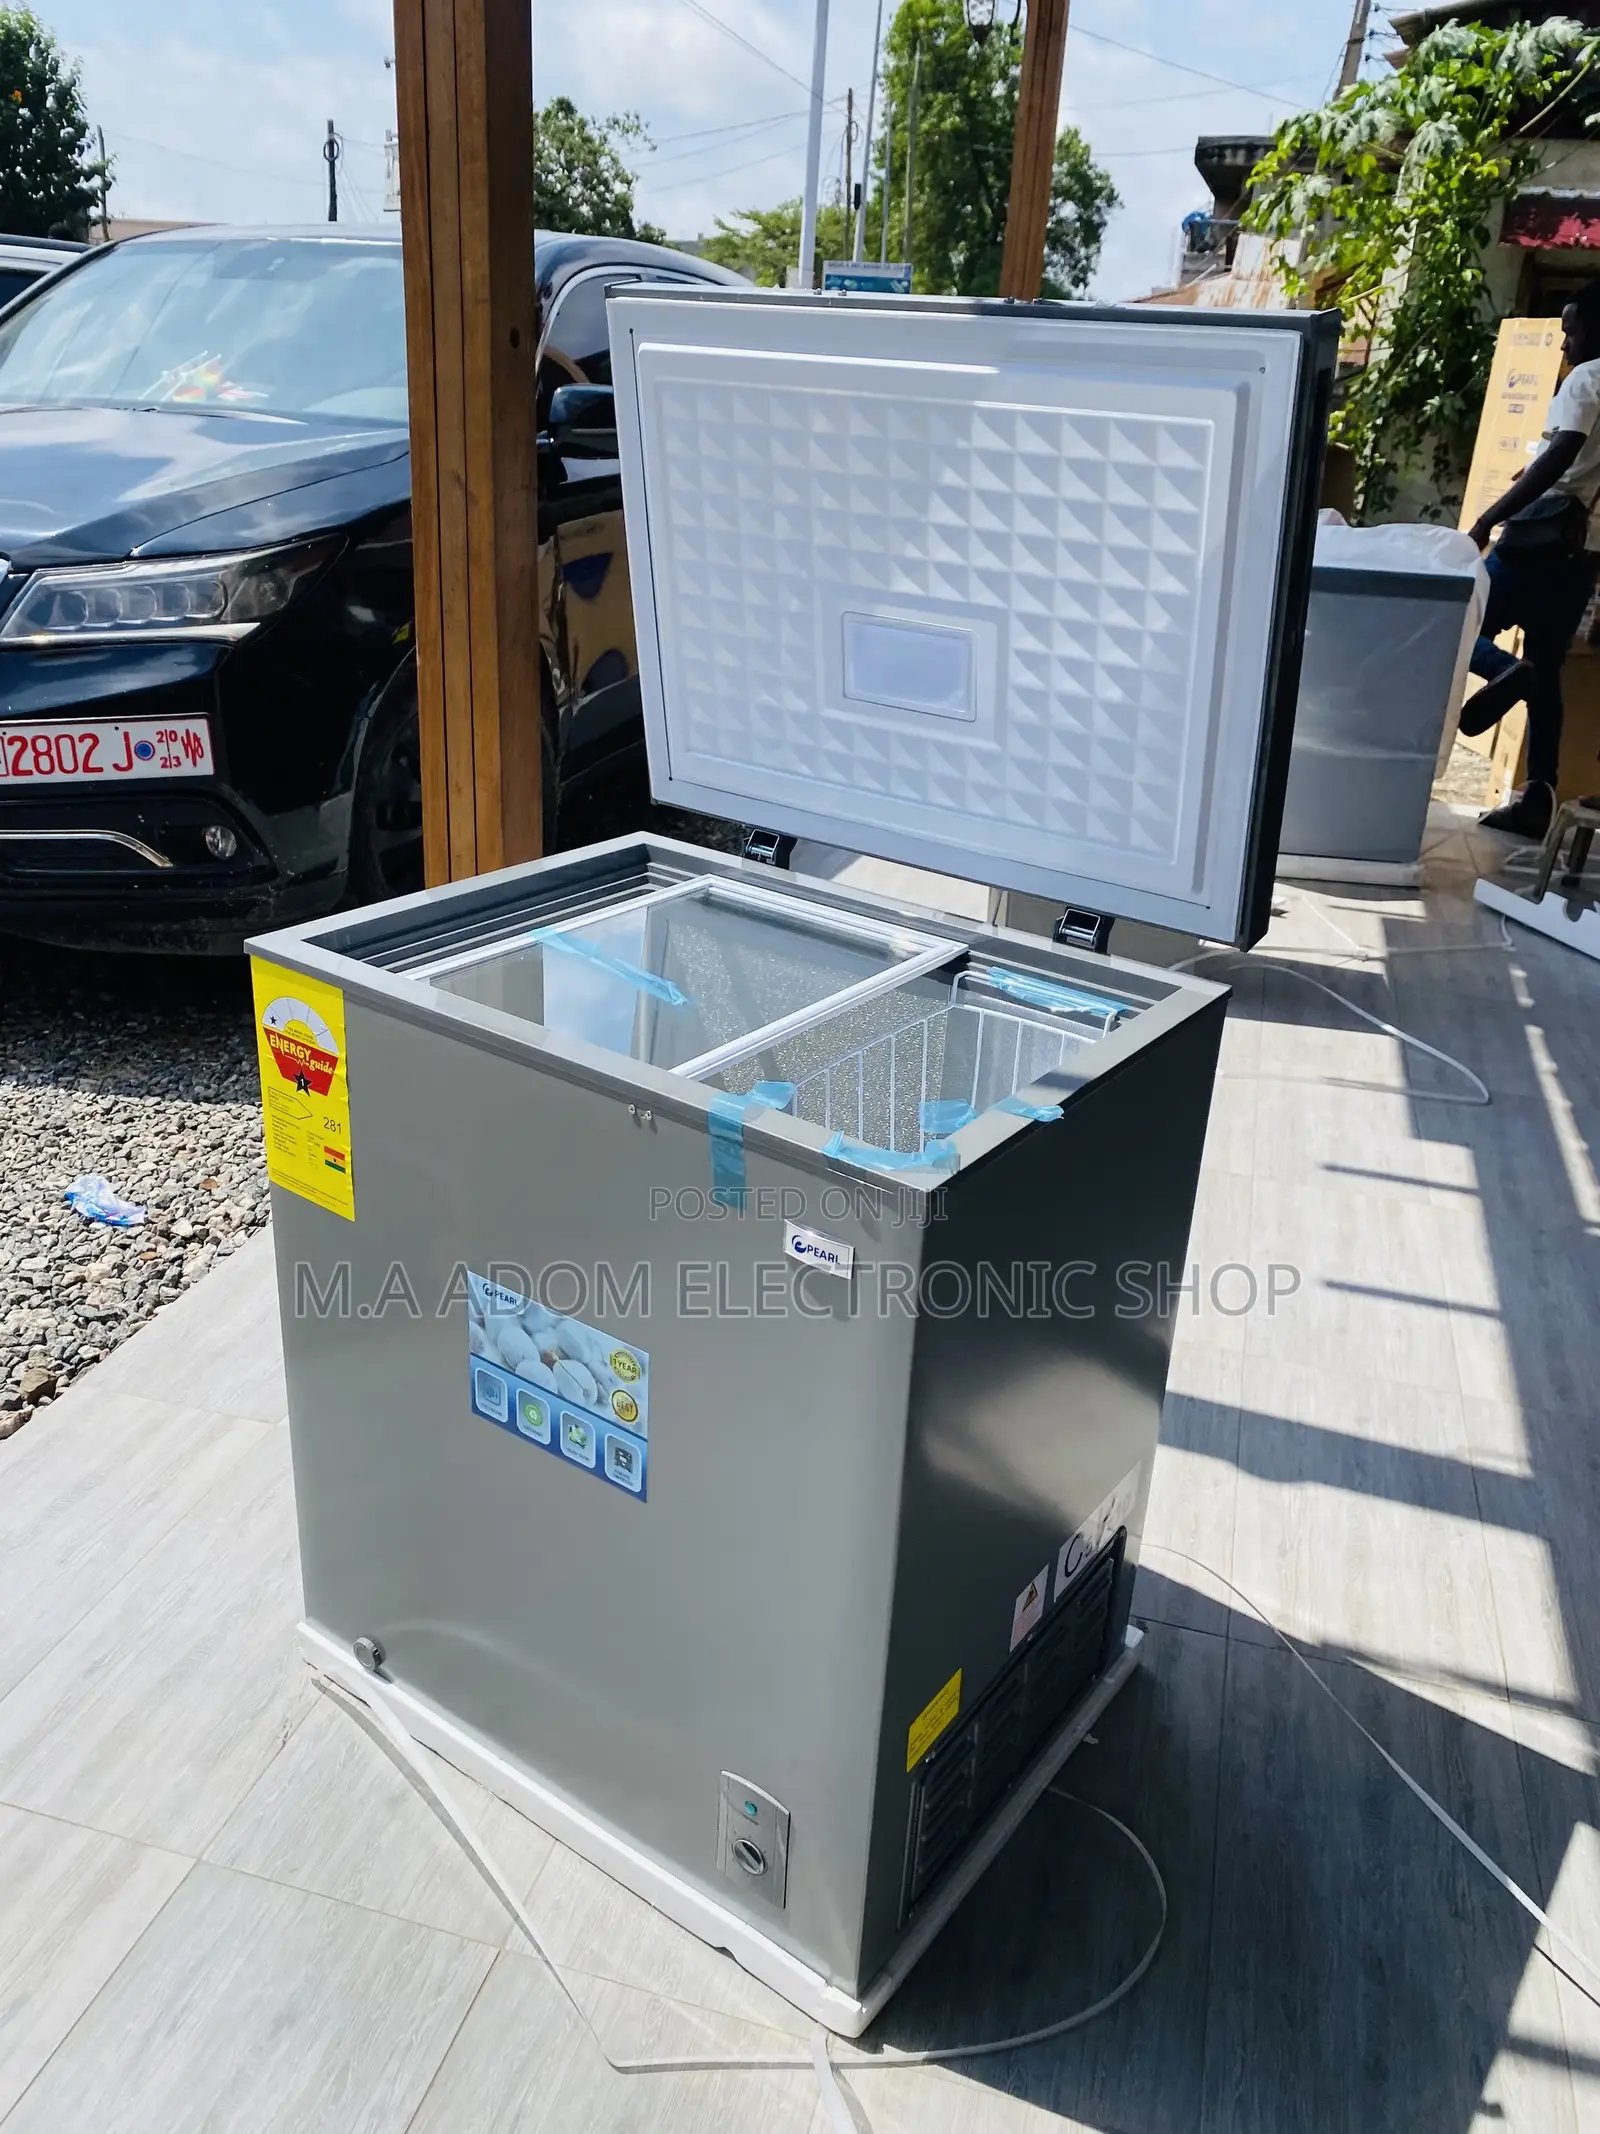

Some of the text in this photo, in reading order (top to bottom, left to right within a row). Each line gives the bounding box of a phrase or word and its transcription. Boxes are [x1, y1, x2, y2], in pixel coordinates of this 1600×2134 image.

[7, 733, 104, 777] 2802
[112, 731, 134, 772] J
[269, 1032, 311, 1061] ENERGY
[309, 1059, 334, 1075] guide
[300, 1078, 305, 1087] 1
[323, 1116, 341, 1135] 281
[806, 1244, 841, 1265] PEARL
[494, 1290, 520, 1307] PEARL
[617, 1360, 637, 1374] YEAR
